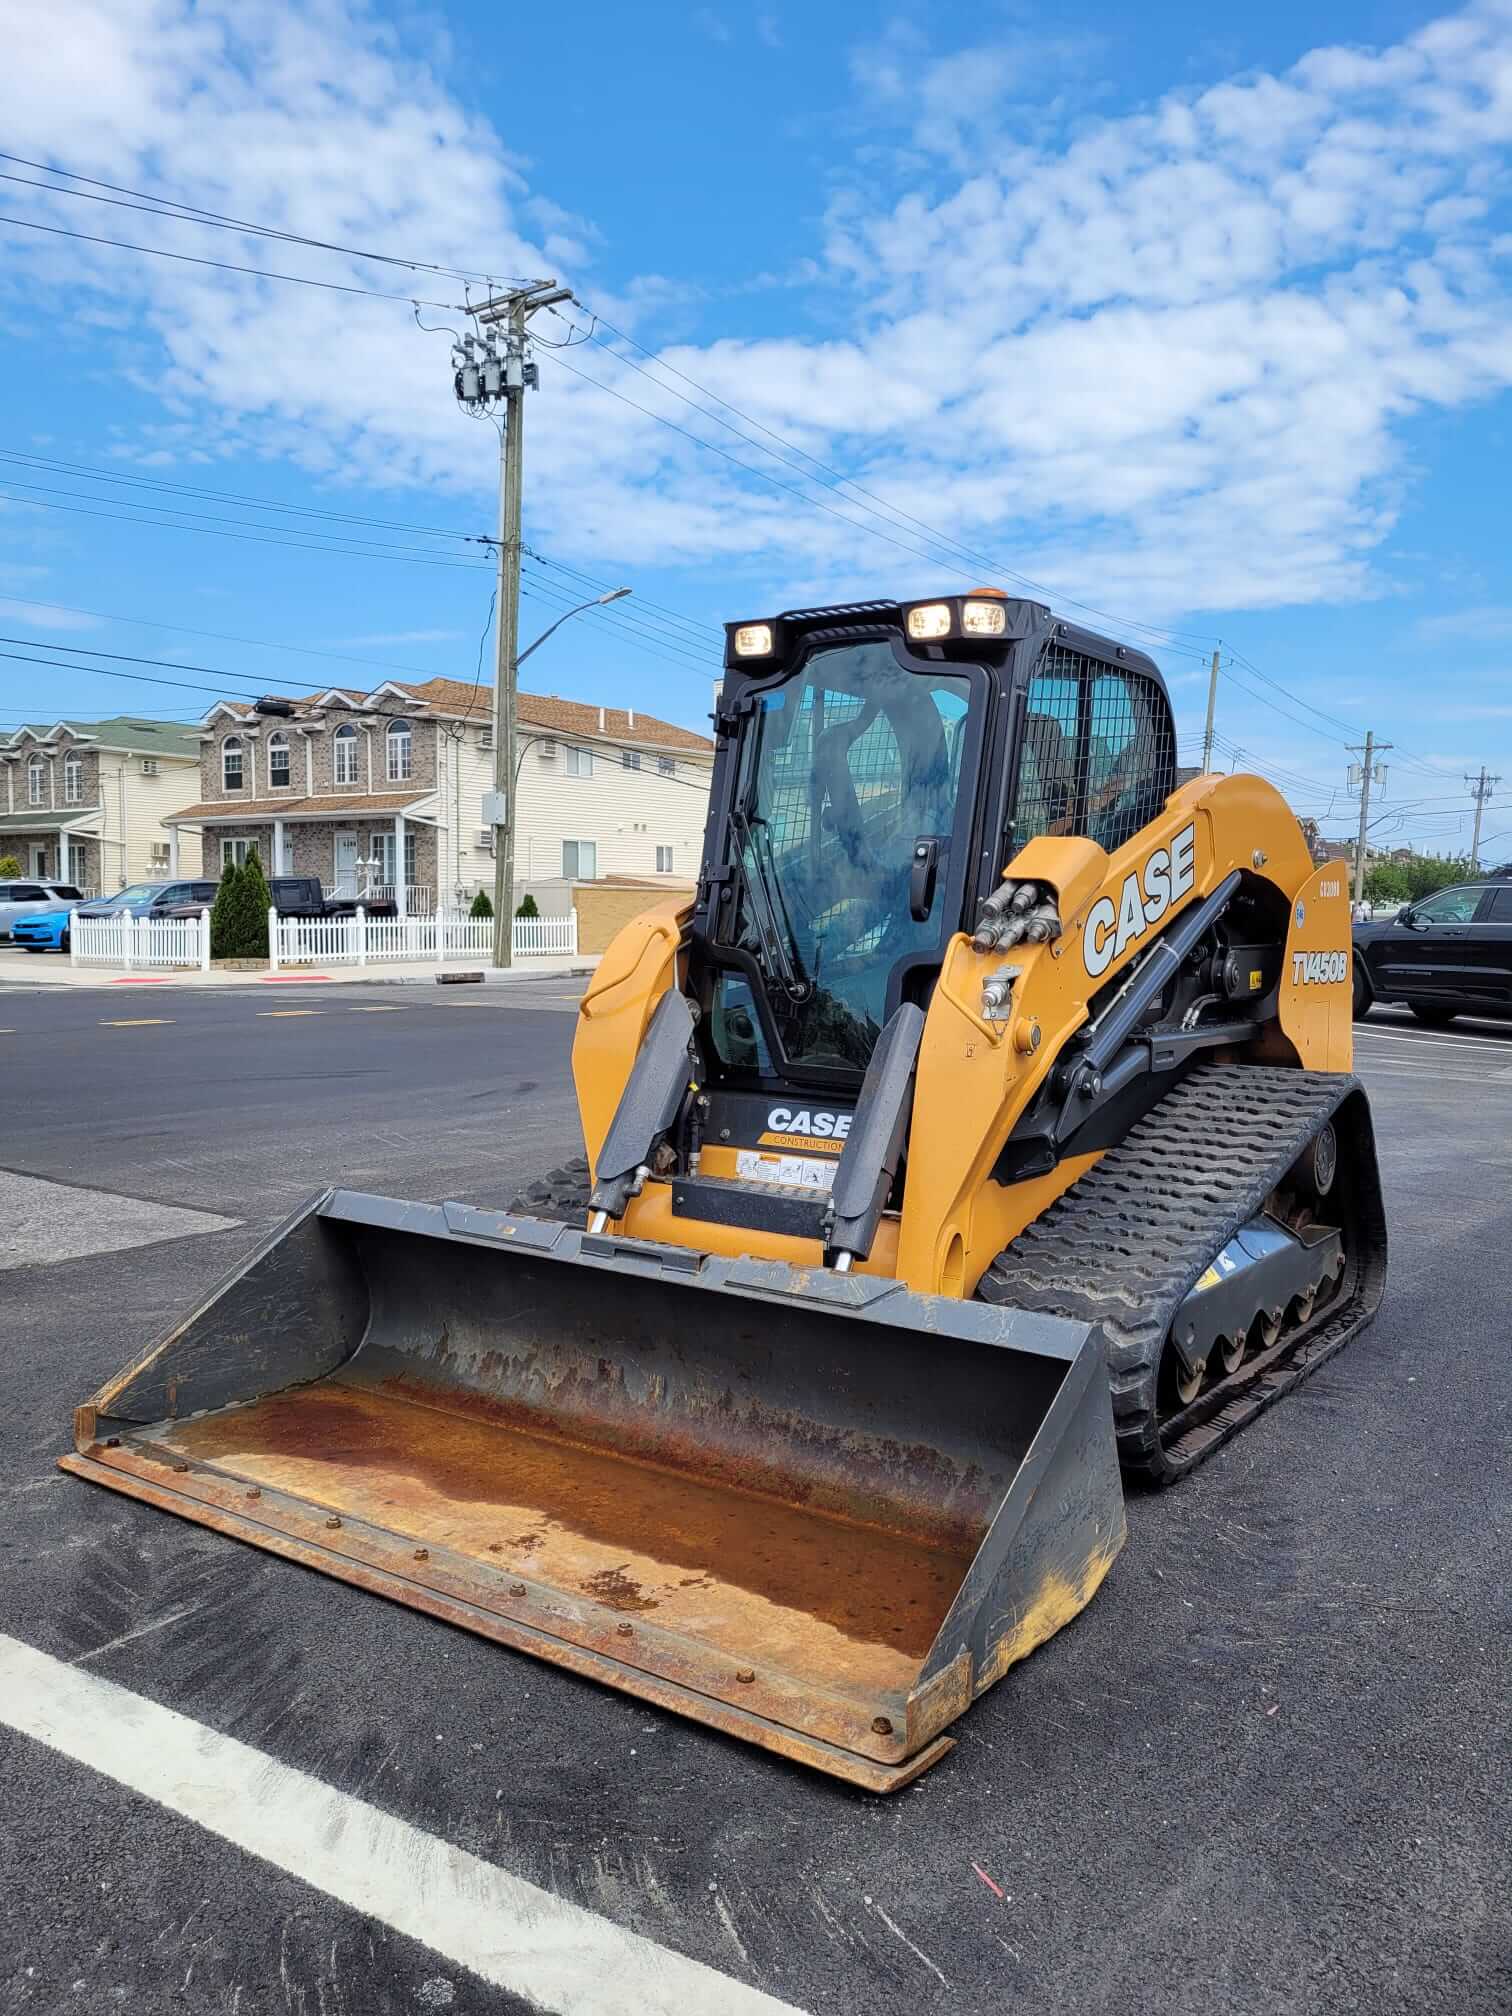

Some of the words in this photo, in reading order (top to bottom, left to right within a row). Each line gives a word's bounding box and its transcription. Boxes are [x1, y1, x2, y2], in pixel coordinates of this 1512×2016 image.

[1083, 822, 1194, 978] CASE
[1292, 951, 1348, 986] TV450B
[767, 1107, 853, 1139] CASE
